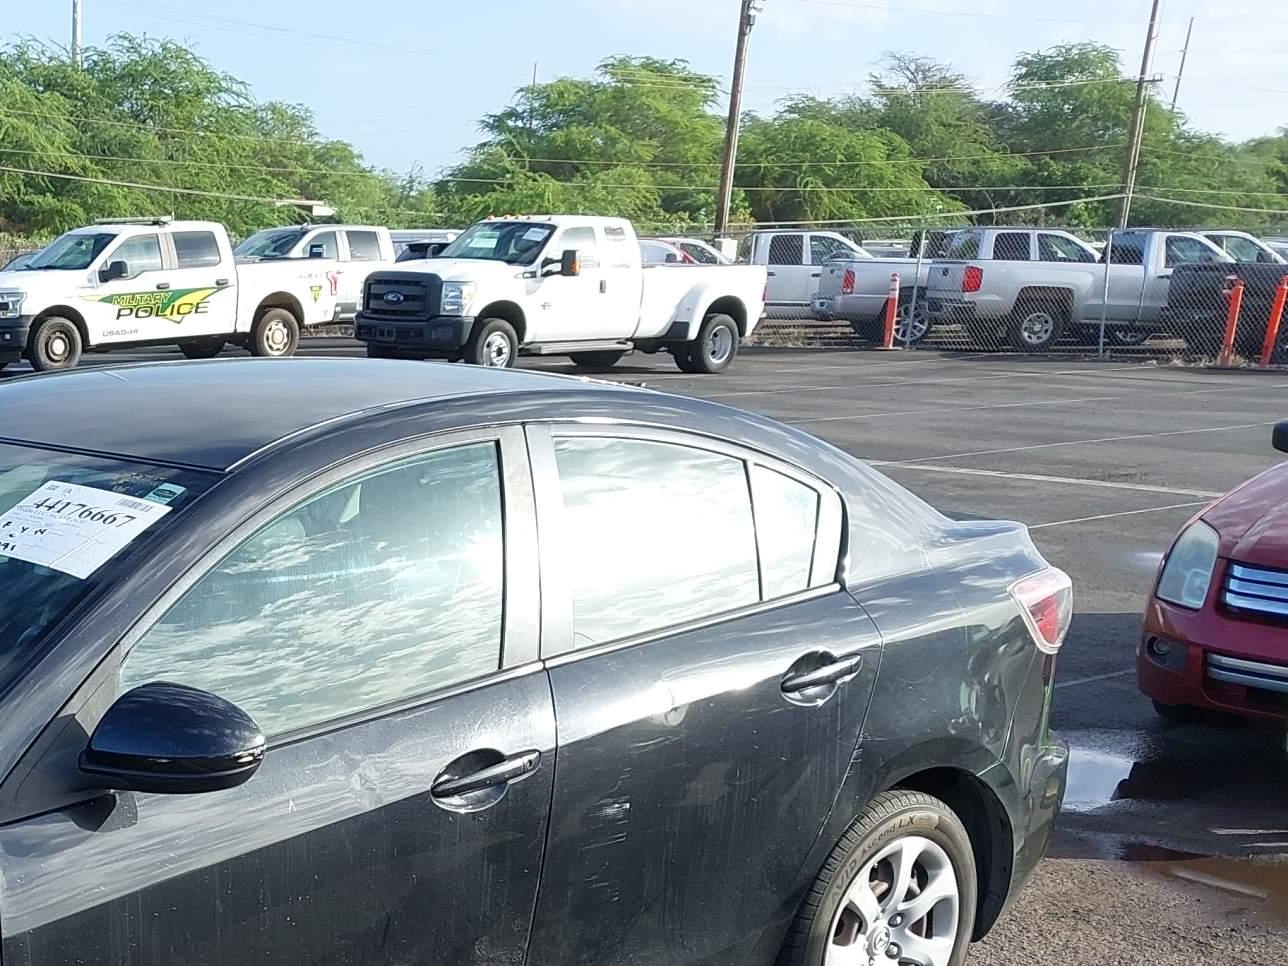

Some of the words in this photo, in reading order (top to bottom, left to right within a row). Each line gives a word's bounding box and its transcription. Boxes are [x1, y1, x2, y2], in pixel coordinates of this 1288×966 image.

[113, 292, 171, 305] MILITARY
[116, 302, 209, 320] POLICE
[33, 497, 136, 527] 44176667
[832, 861, 857, 900] AVID
[861, 823, 896, 858] Ascend
[899, 815, 916, 828] LX
